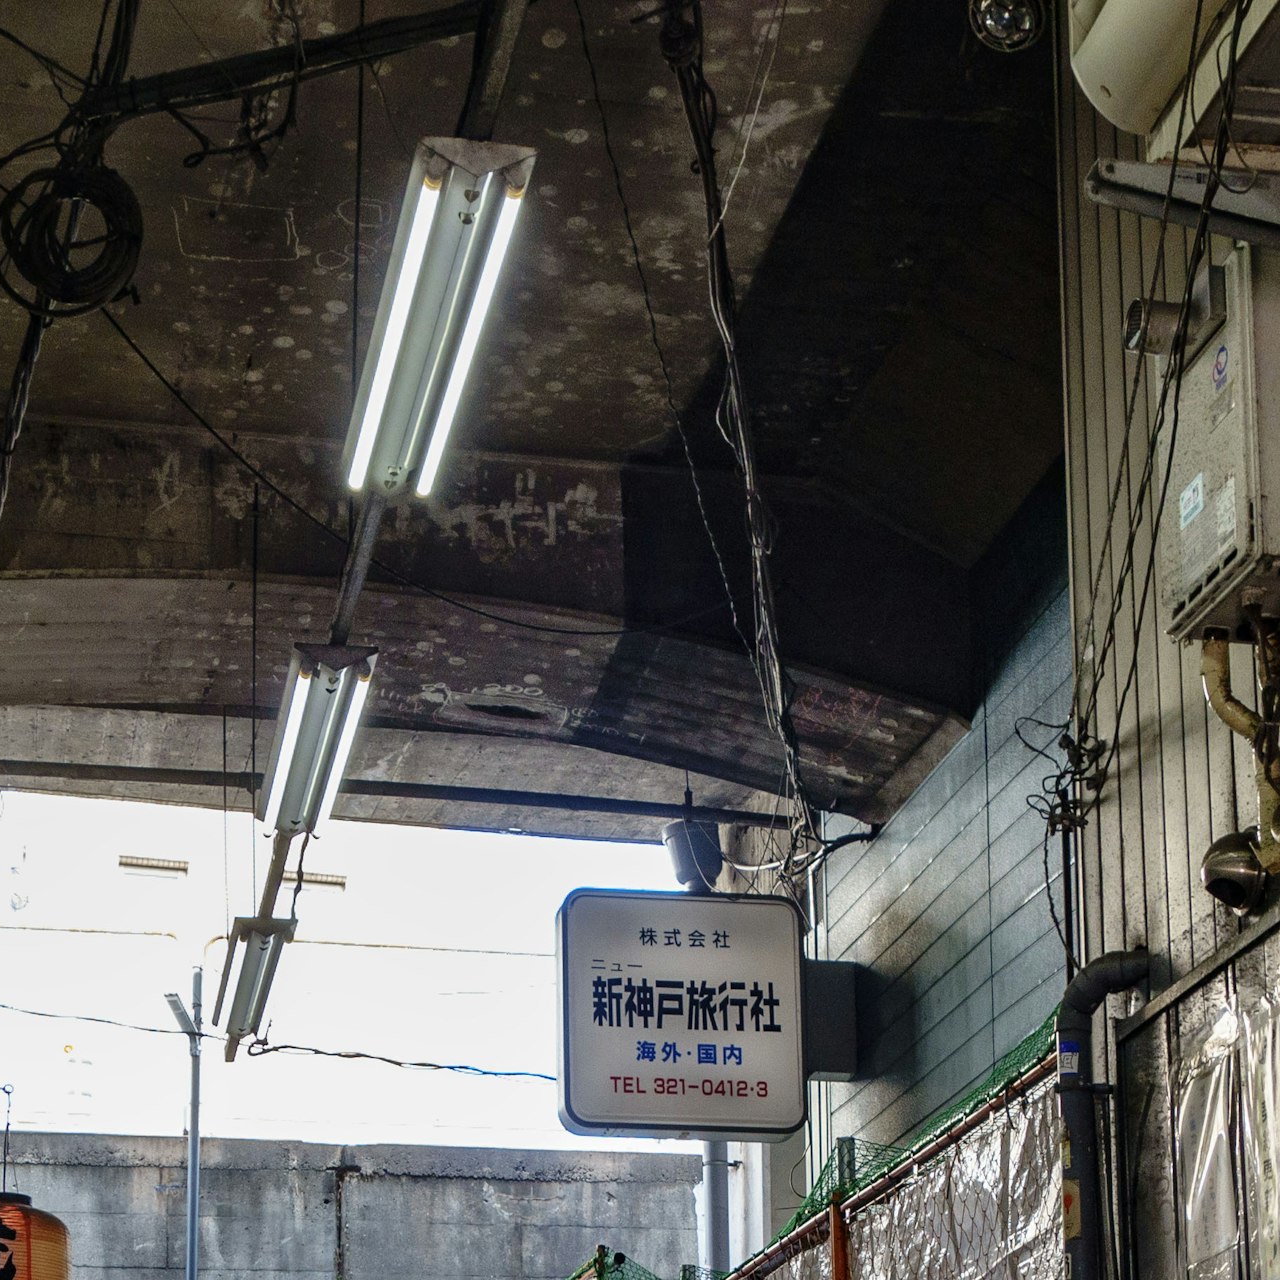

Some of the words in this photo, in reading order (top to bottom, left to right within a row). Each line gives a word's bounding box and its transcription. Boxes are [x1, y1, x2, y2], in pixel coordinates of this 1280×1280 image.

[639, 926, 731, 949] 株式会社
[590, 958, 643, 973] ニュー
[591, 975, 782, 1034] 新神戸旅行社
[610, 1075, 647, 1095] TEL
